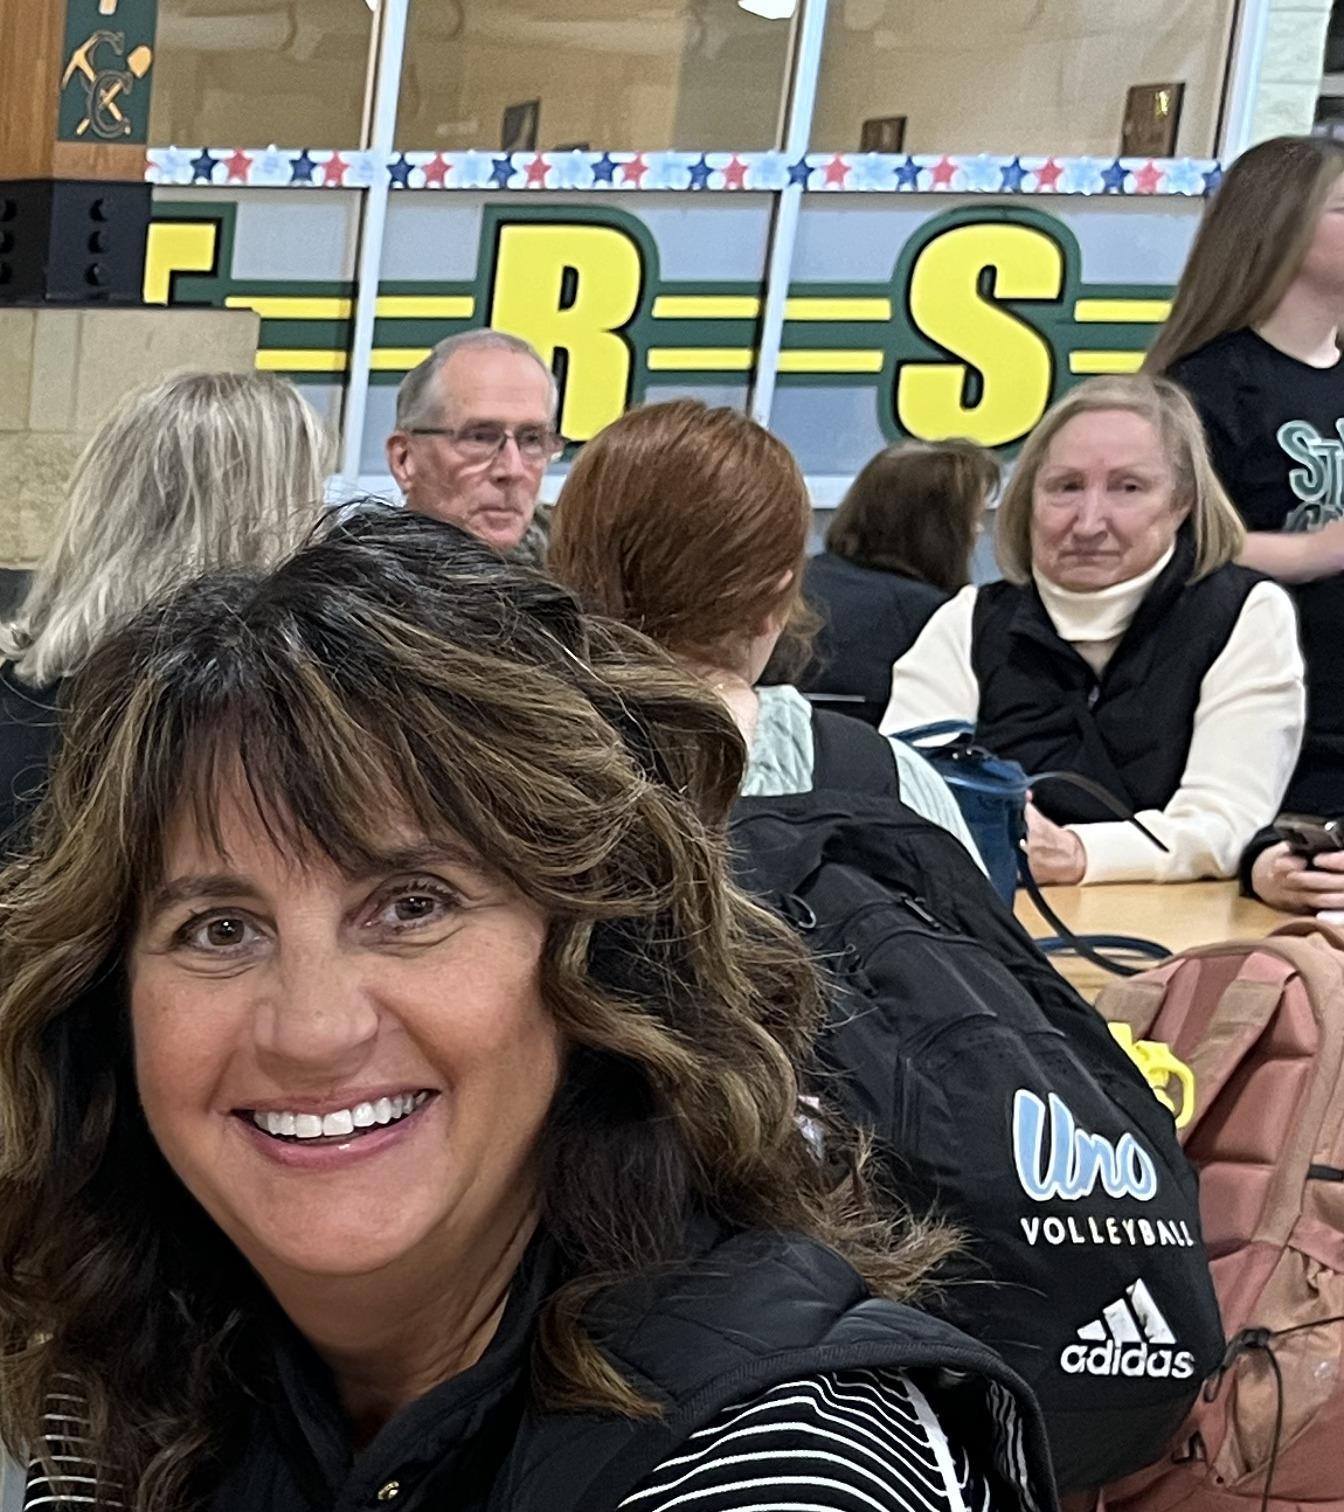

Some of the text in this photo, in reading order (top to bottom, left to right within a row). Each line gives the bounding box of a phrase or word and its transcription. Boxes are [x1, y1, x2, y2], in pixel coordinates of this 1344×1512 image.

[1276, 417, 1344, 505] ST
[1012, 1088, 1158, 1202] Uno
[1020, 1215, 1195, 1248] VOLLEYBALL
[1060, 1339, 1195, 1379] adidas
